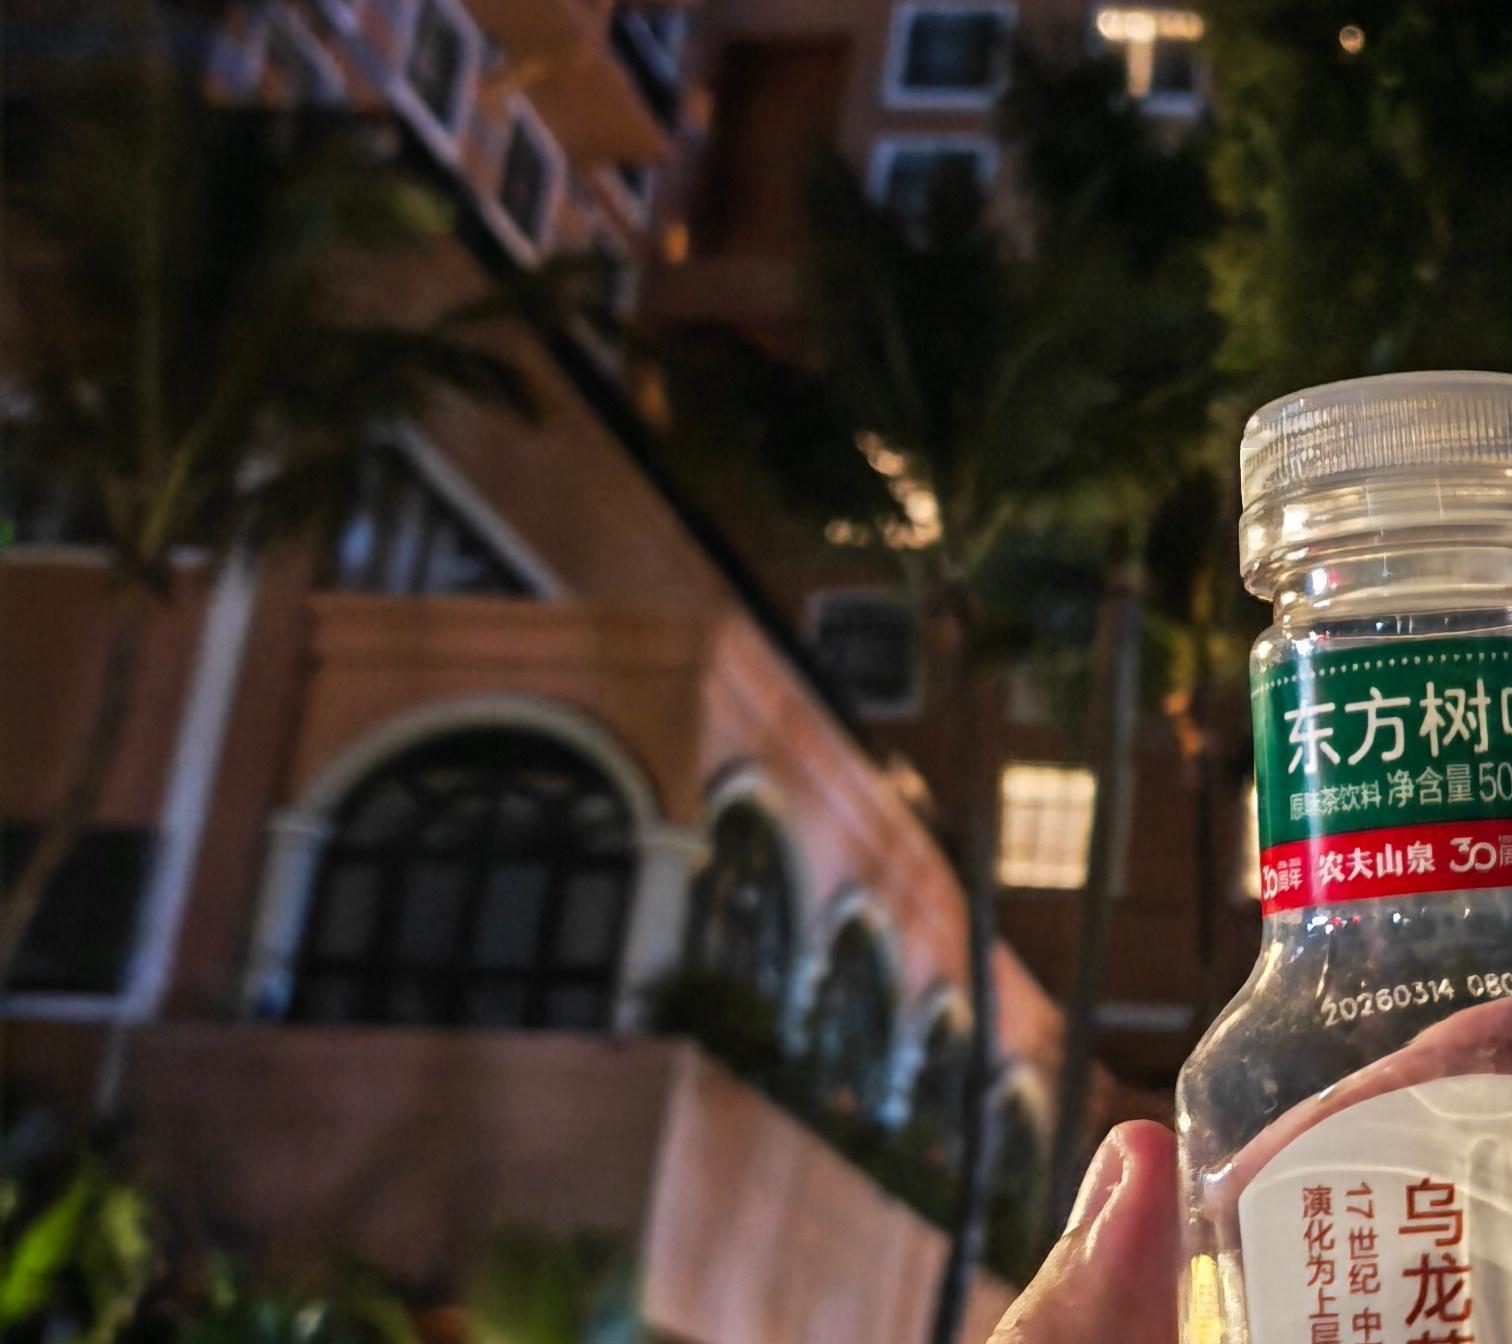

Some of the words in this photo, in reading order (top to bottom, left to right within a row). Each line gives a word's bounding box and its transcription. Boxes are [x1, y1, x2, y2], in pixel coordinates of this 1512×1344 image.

[1317, 839, 1436, 885] 农夫山泉
[1321, 977, 1455, 1027] 20260314
